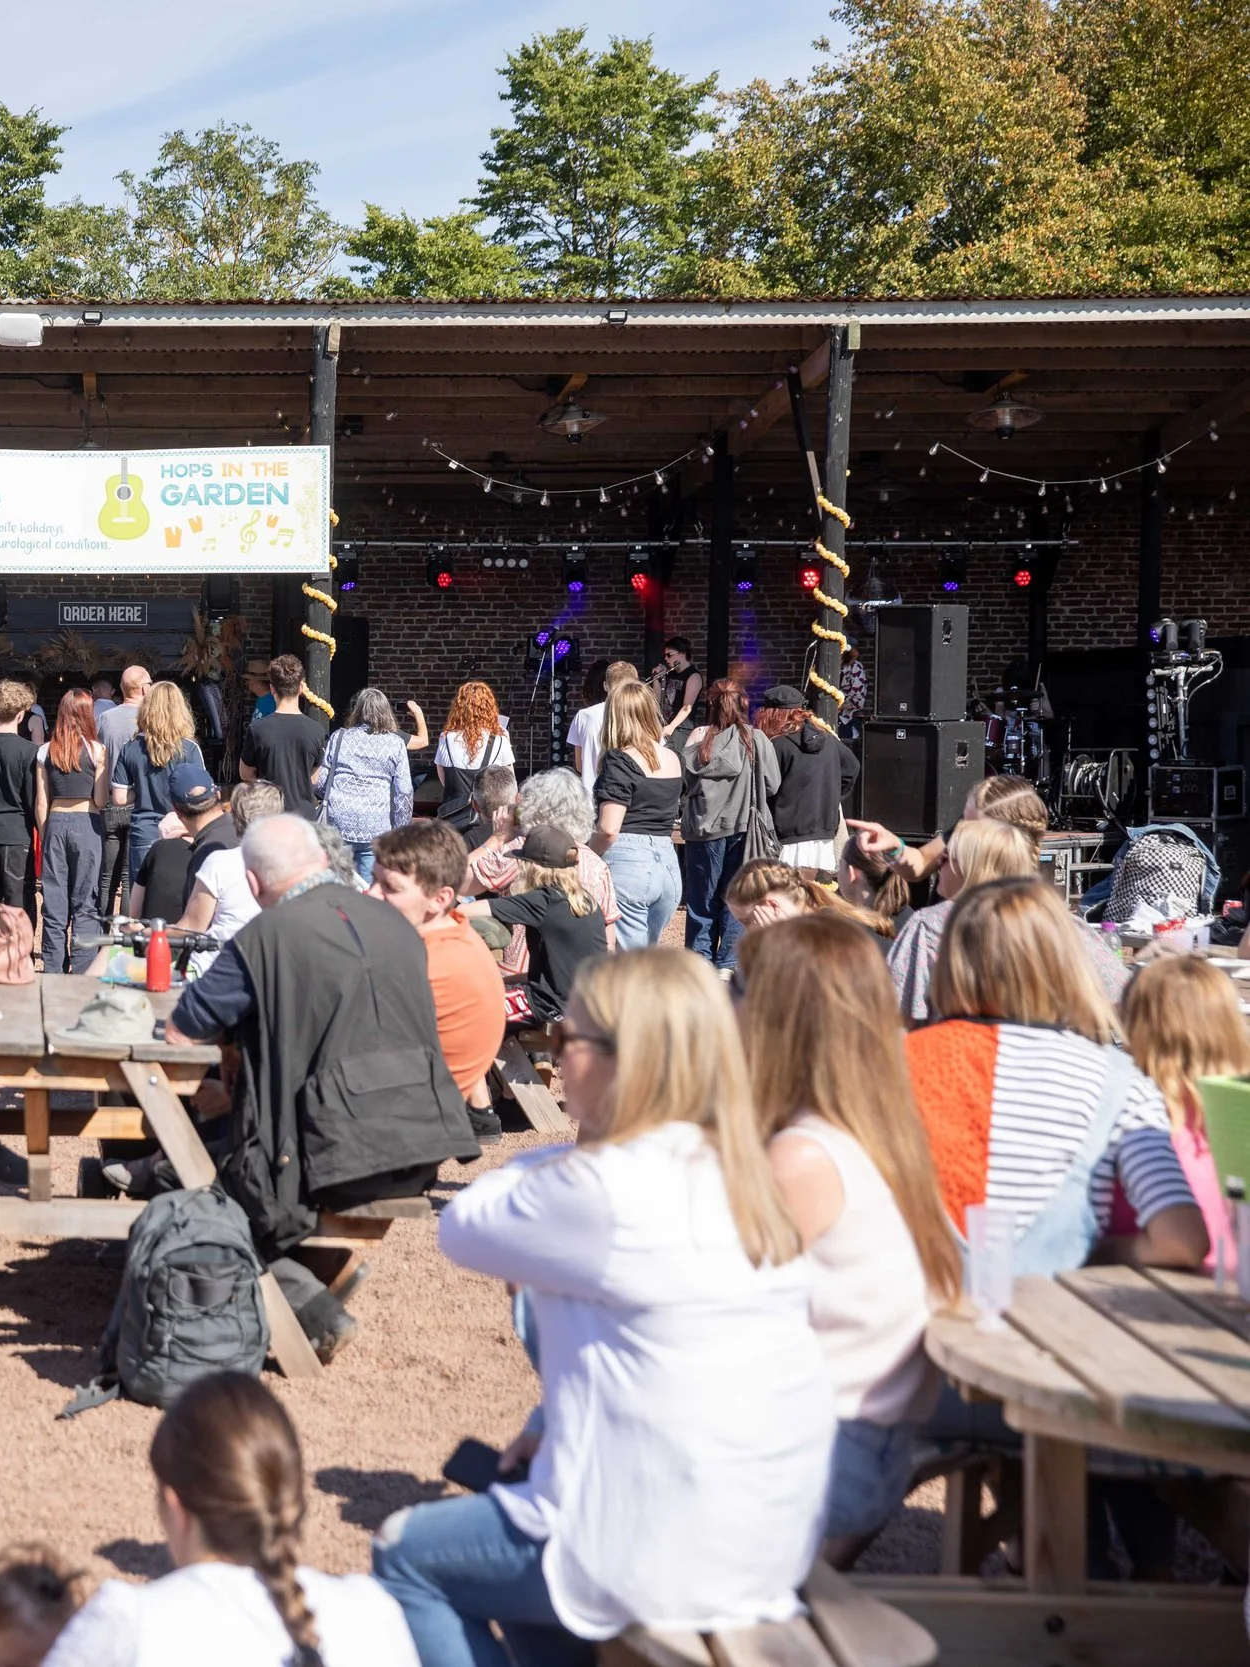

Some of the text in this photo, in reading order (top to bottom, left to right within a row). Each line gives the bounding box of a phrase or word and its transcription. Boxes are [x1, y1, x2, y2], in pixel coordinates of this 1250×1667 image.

[160, 461, 289, 479] HOPS IN THE
[160, 482, 289, 507] GARDEN
[19, 521, 64, 538] holidays
[54, 537, 112, 550] conditions.
[63, 606, 142, 622] ORDER HERE
